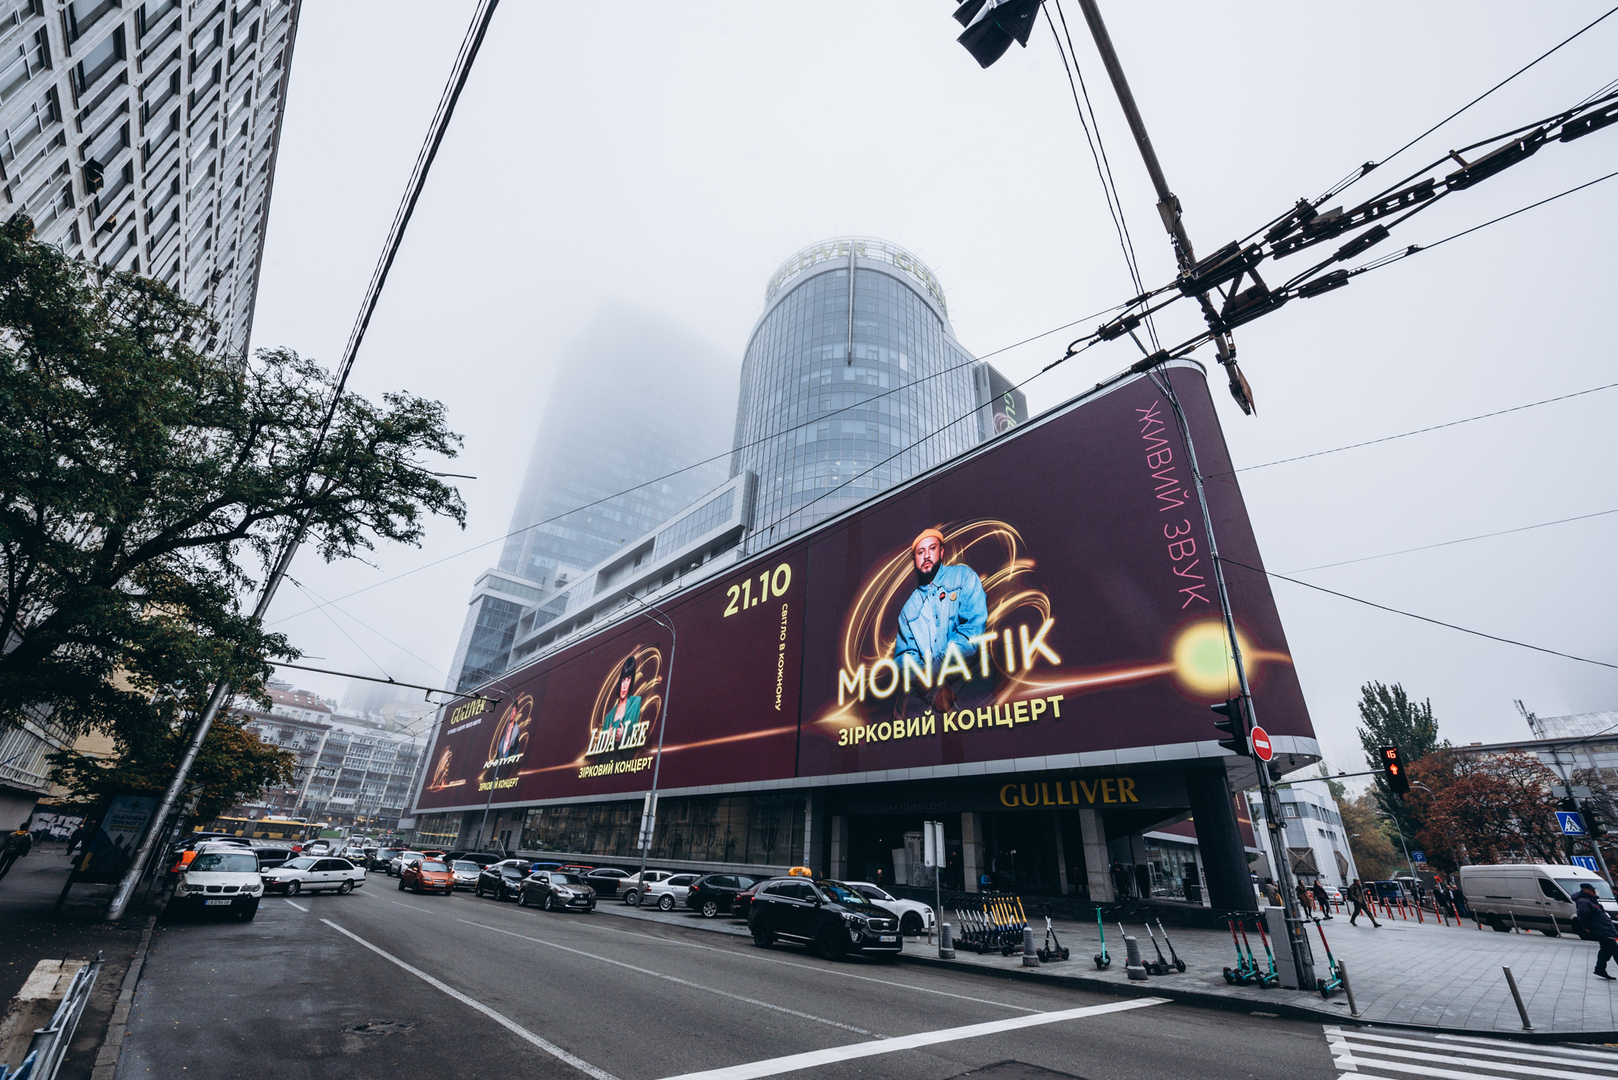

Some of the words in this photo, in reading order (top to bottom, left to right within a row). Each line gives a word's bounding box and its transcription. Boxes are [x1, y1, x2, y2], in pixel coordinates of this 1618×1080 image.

[1135, 400, 1190, 512] ЖИВИЙ
[1164, 518, 1210, 609] ЗВУК
[723, 562, 792, 618] 21.10
[779, 603, 788, 641] СВІТЛО
[779, 643, 786, 651] В
[837, 617, 1062, 706] MONATIK
[774, 652, 785, 711] КОЖНОМУ
[585, 728, 616, 756] LIDA
[618, 720, 650, 750] LEE
[837, 709, 936, 747] ЗІРКОВИЙ
[943, 694, 1064, 733] КОНЦЕРТ
[578, 760, 614, 778] ЗІРКОВИЙ
[614, 757, 653, 773] КОНЦЕРТ
[1000, 777, 1139, 807] GULLIVER
